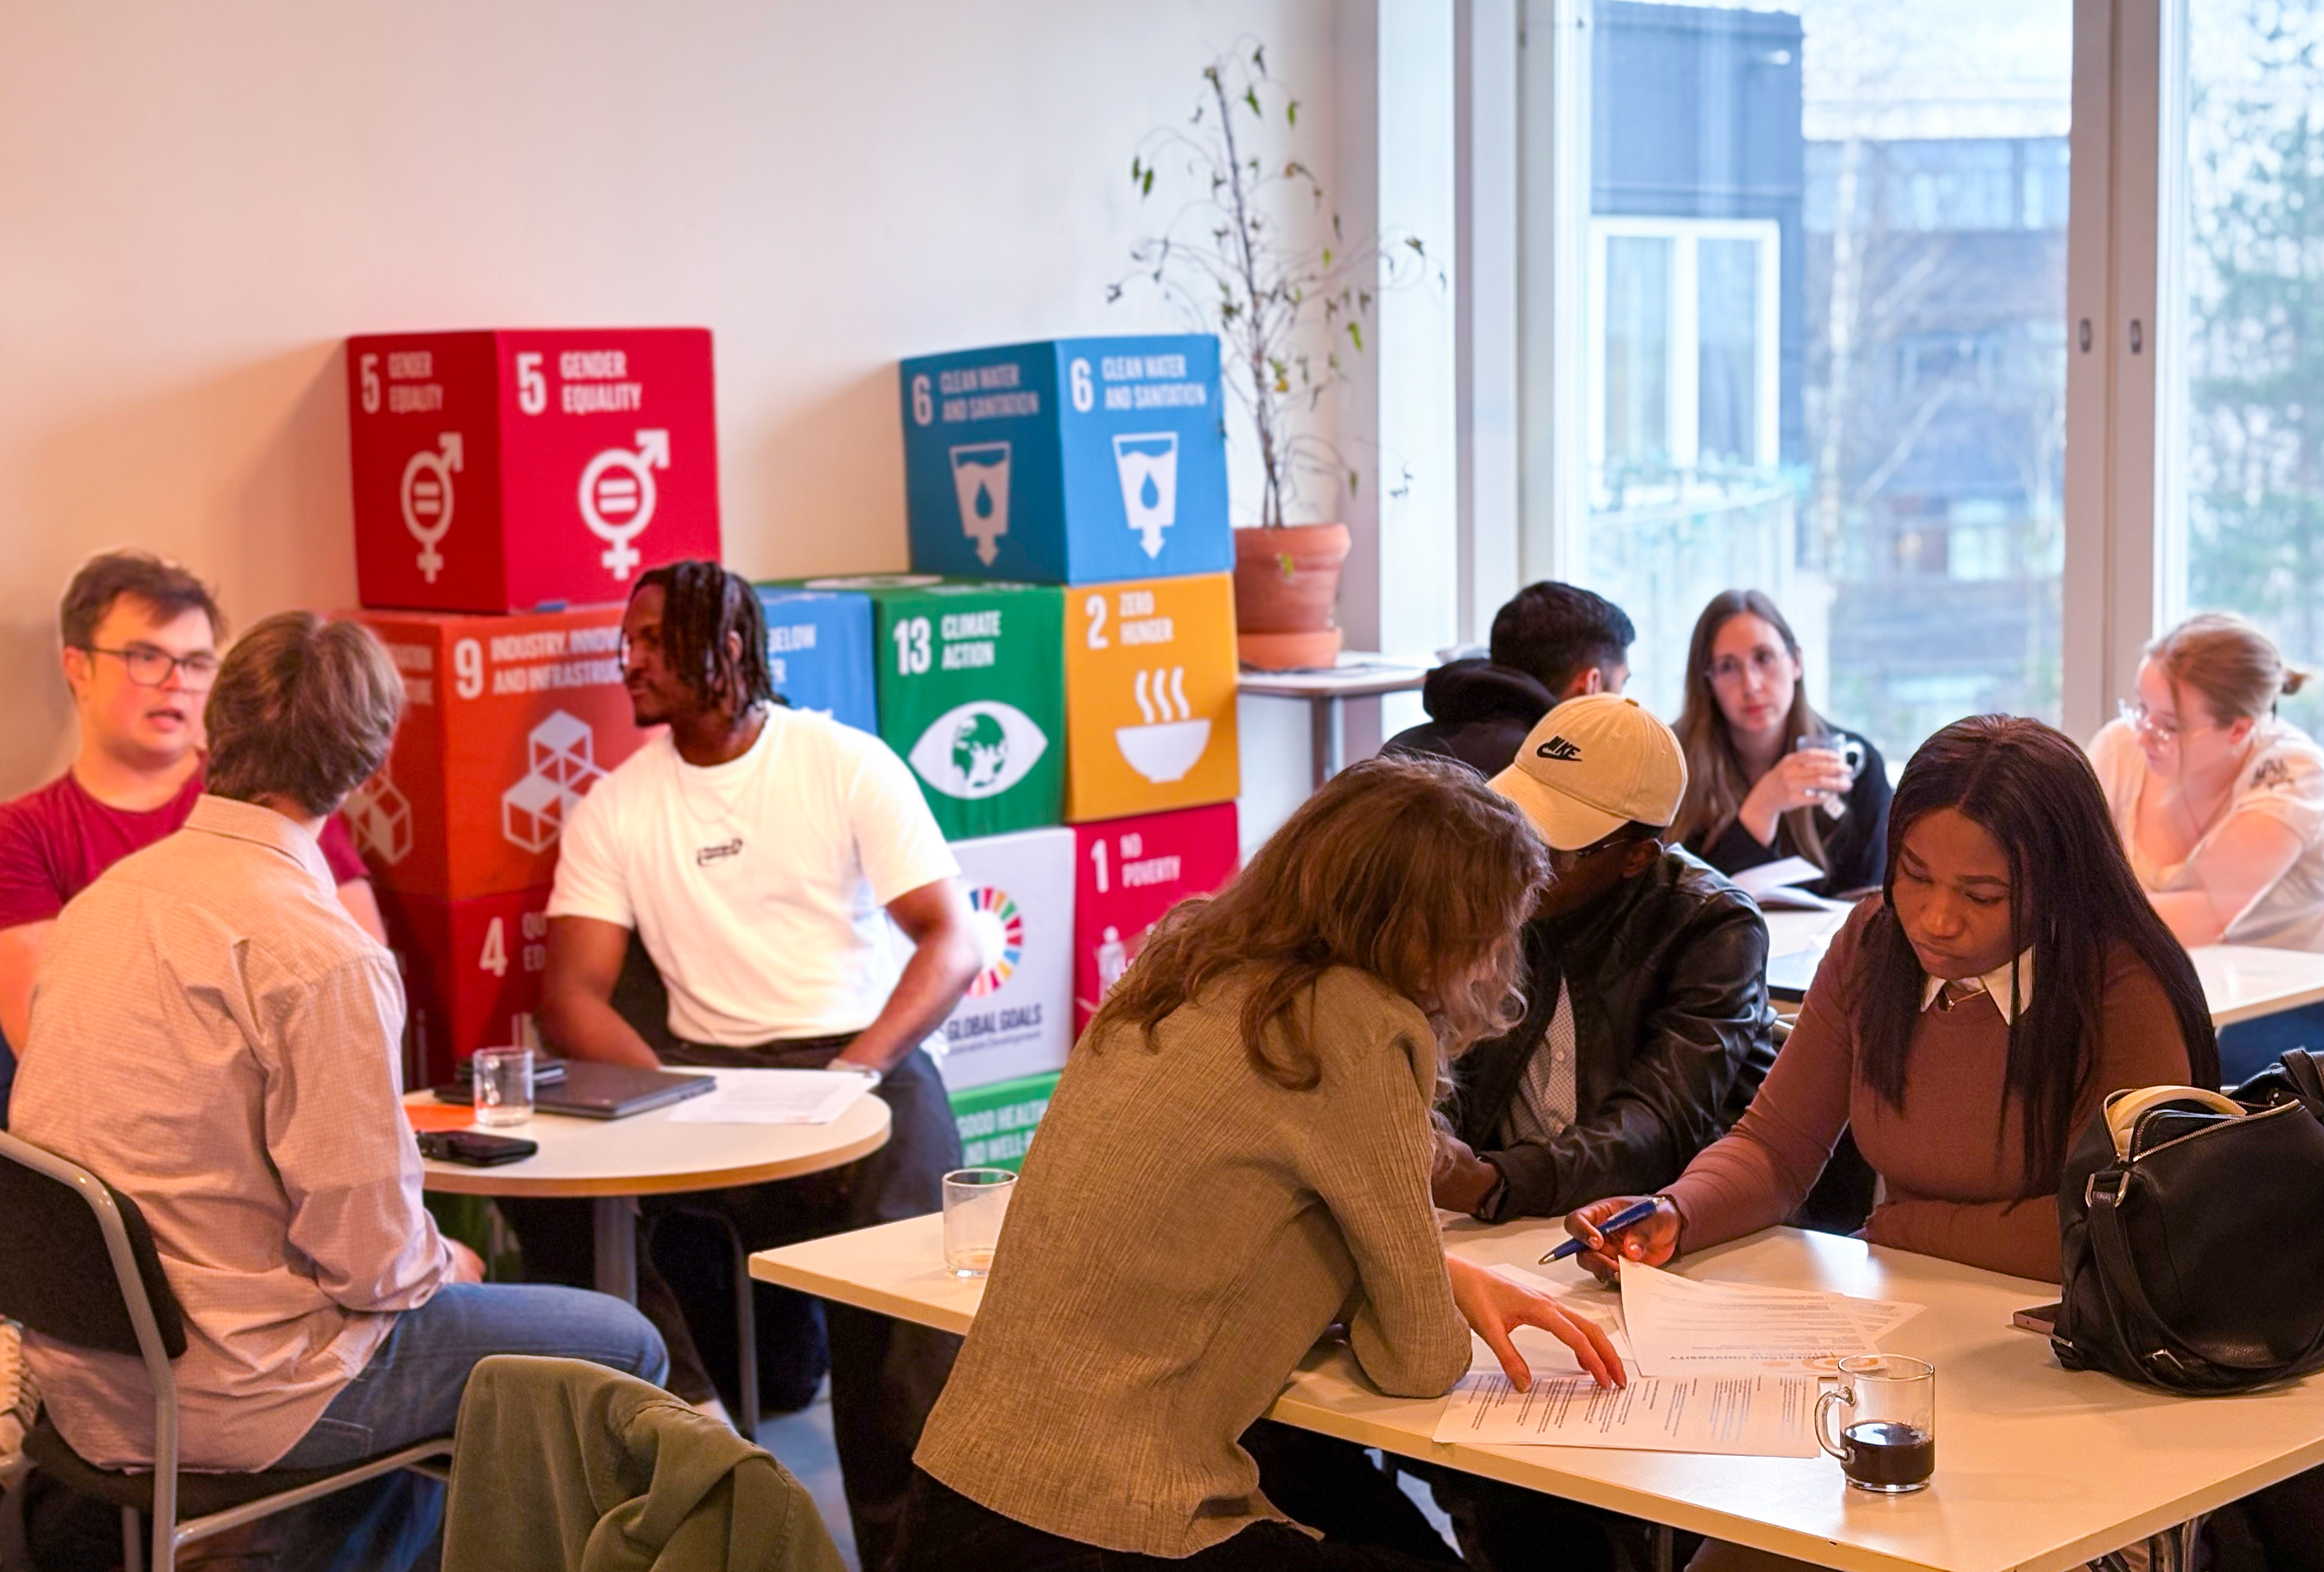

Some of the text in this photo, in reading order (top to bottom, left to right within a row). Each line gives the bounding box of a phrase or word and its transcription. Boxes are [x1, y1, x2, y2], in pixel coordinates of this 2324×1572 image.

[561, 350, 627, 380] GENDER
[940, 363, 1019, 394] CLEAN WATER
[1101, 353, 1187, 381] CLEAN WATER
[360, 353, 380, 414] 5
[516, 351, 546, 415] 5
[562, 383, 642, 415] EQUALITY
[1070, 357, 1094, 413] 6
[1105, 382, 1206, 410] AND SANITATION
[913, 374, 932, 425] 6
[943, 390, 1039, 422] AND SANITATION
[1119, 590, 1154, 618] ZERO
[940, 610, 1001, 641] CLIMATE
[1086, 594, 1109, 650] 2
[1120, 616, 1175, 646] HUNGER
[893, 616, 931, 675] 13
[941, 640, 995, 672] ACTION
[454, 638, 484, 700] 9
[493, 667, 526, 696] AND
[1120, 832, 1142, 859] NO
[1091, 839, 1109, 894] 1
[1122, 855, 1182, 888] POVERTY
[479, 917, 508, 977] 4
[948, 1004, 1042, 1042] GLOBAL GOALS
